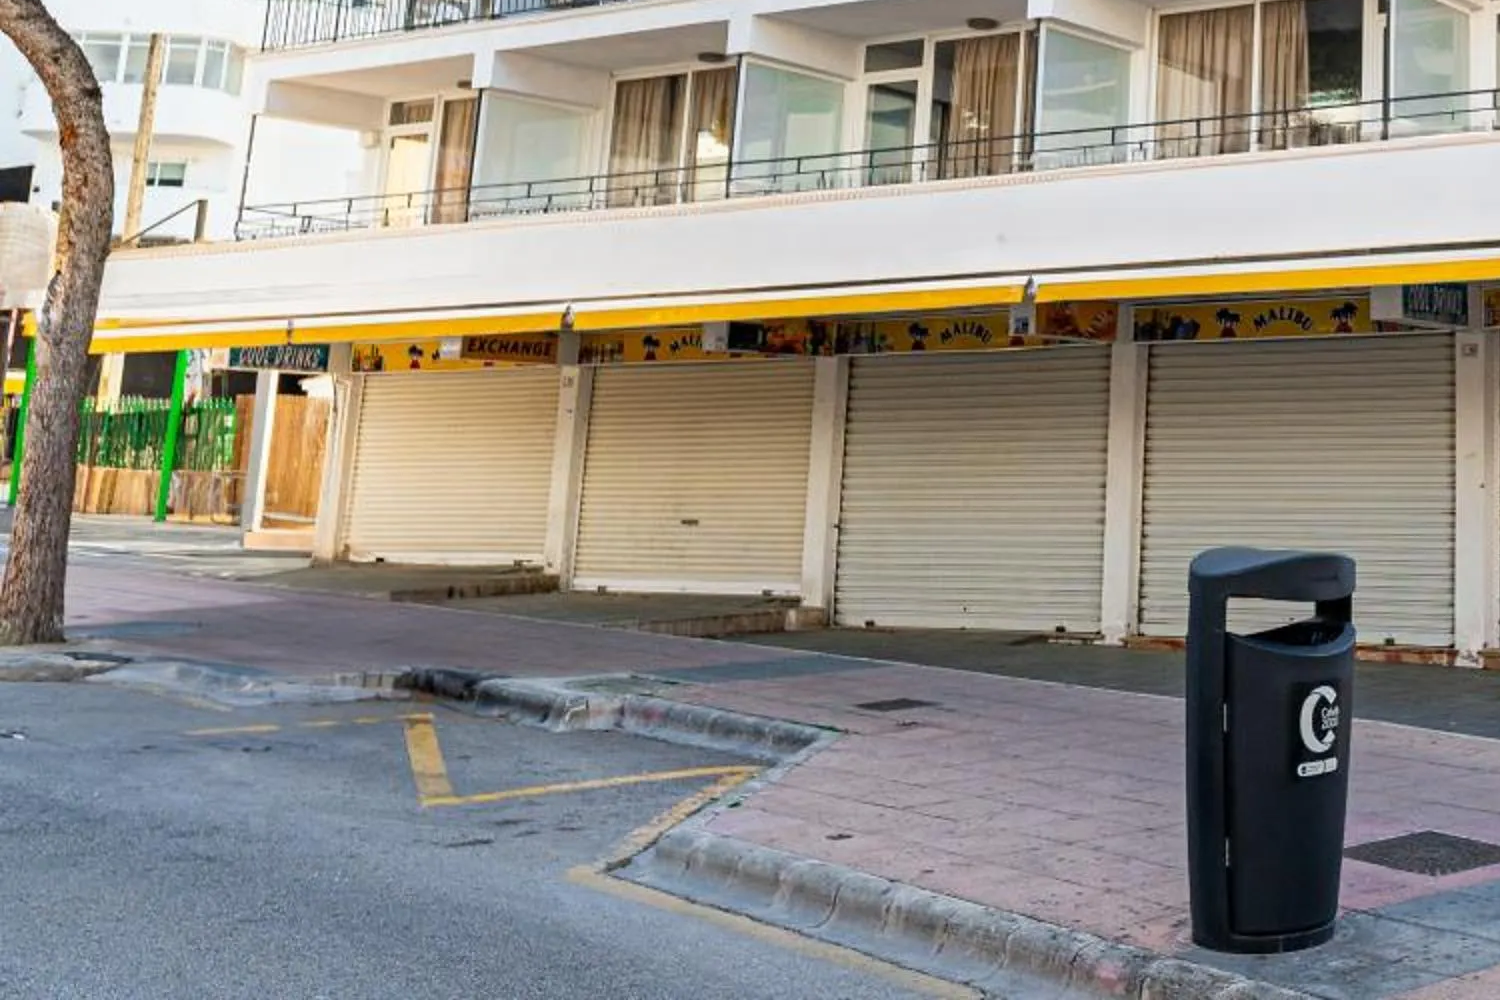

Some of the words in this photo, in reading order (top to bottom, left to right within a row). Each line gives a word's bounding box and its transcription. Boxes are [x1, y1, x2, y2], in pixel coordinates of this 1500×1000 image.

[1253, 305, 1314, 331] MALIBU
[669, 335, 703, 352] MALI
[940, 322, 992, 344] MALIBU
[275, 346, 320, 368] DRINKS
[468, 337, 553, 357] EXCHANGE
